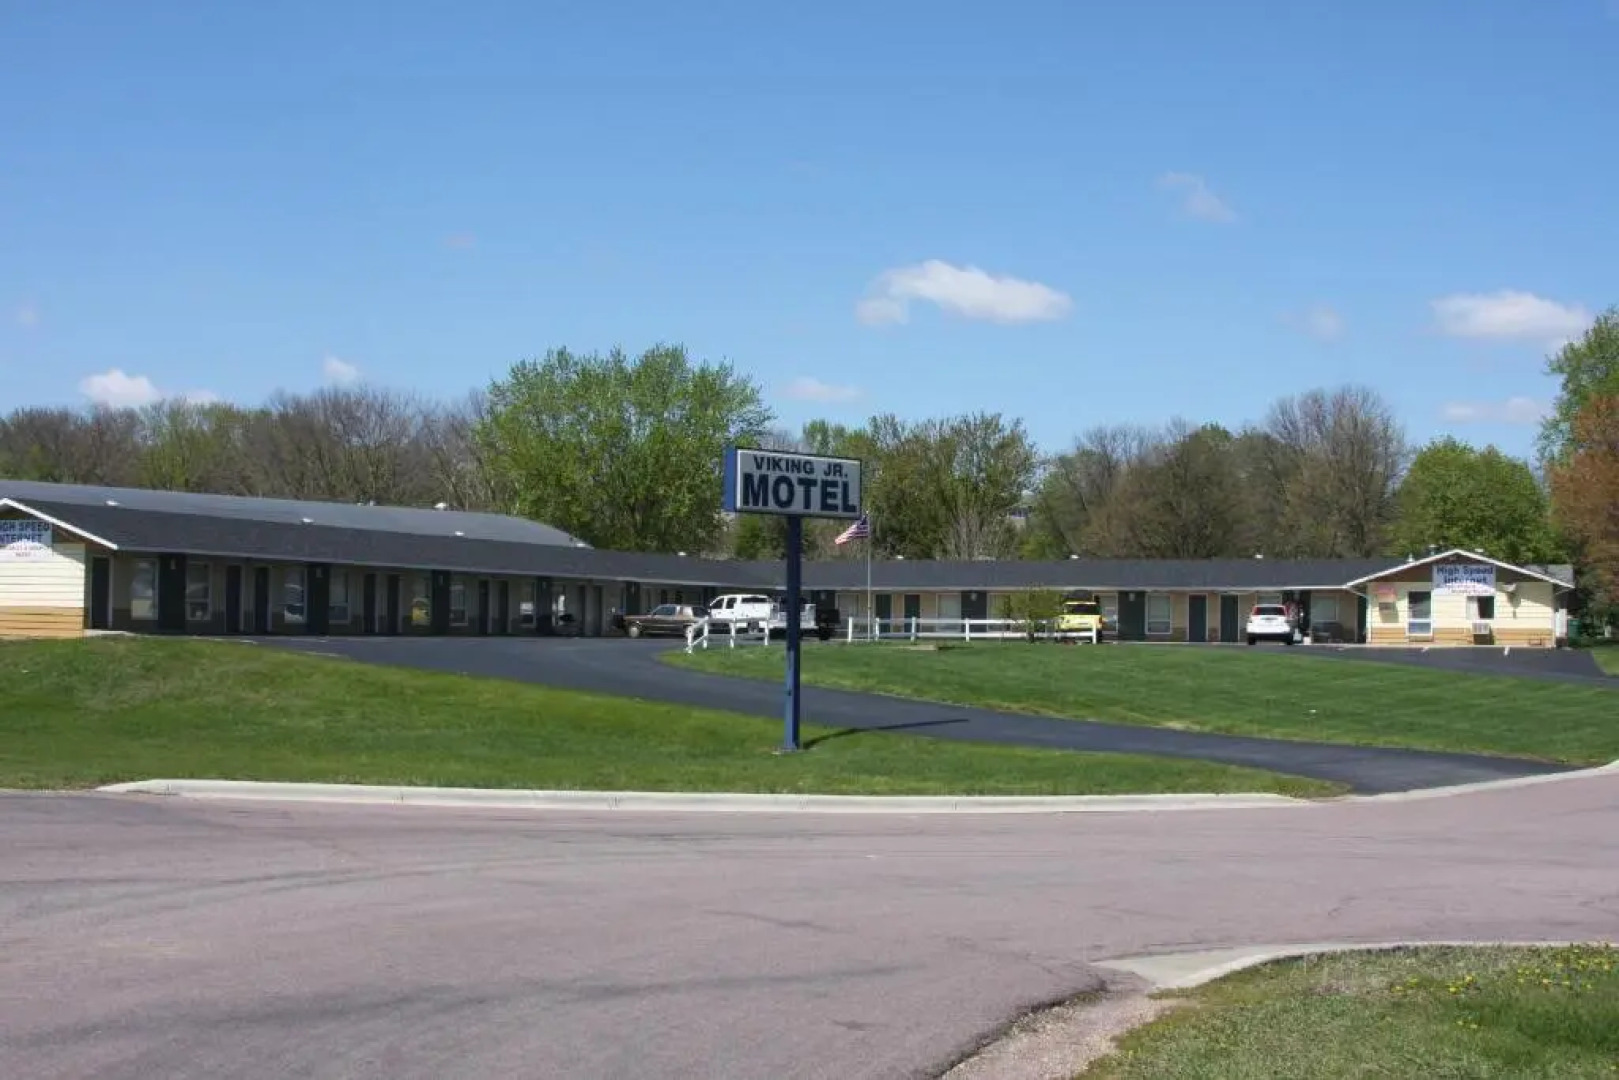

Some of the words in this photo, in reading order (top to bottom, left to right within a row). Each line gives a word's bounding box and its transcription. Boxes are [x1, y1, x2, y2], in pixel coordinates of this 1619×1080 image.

[753, 455, 815, 475] VIKING
[823, 462, 848, 478] JR.
[742, 472, 857, 512] MOTEL
[18, 521, 50, 532] SPEED
[1437, 566, 1460, 576] High
[1463, 566, 1493, 576] Speed
